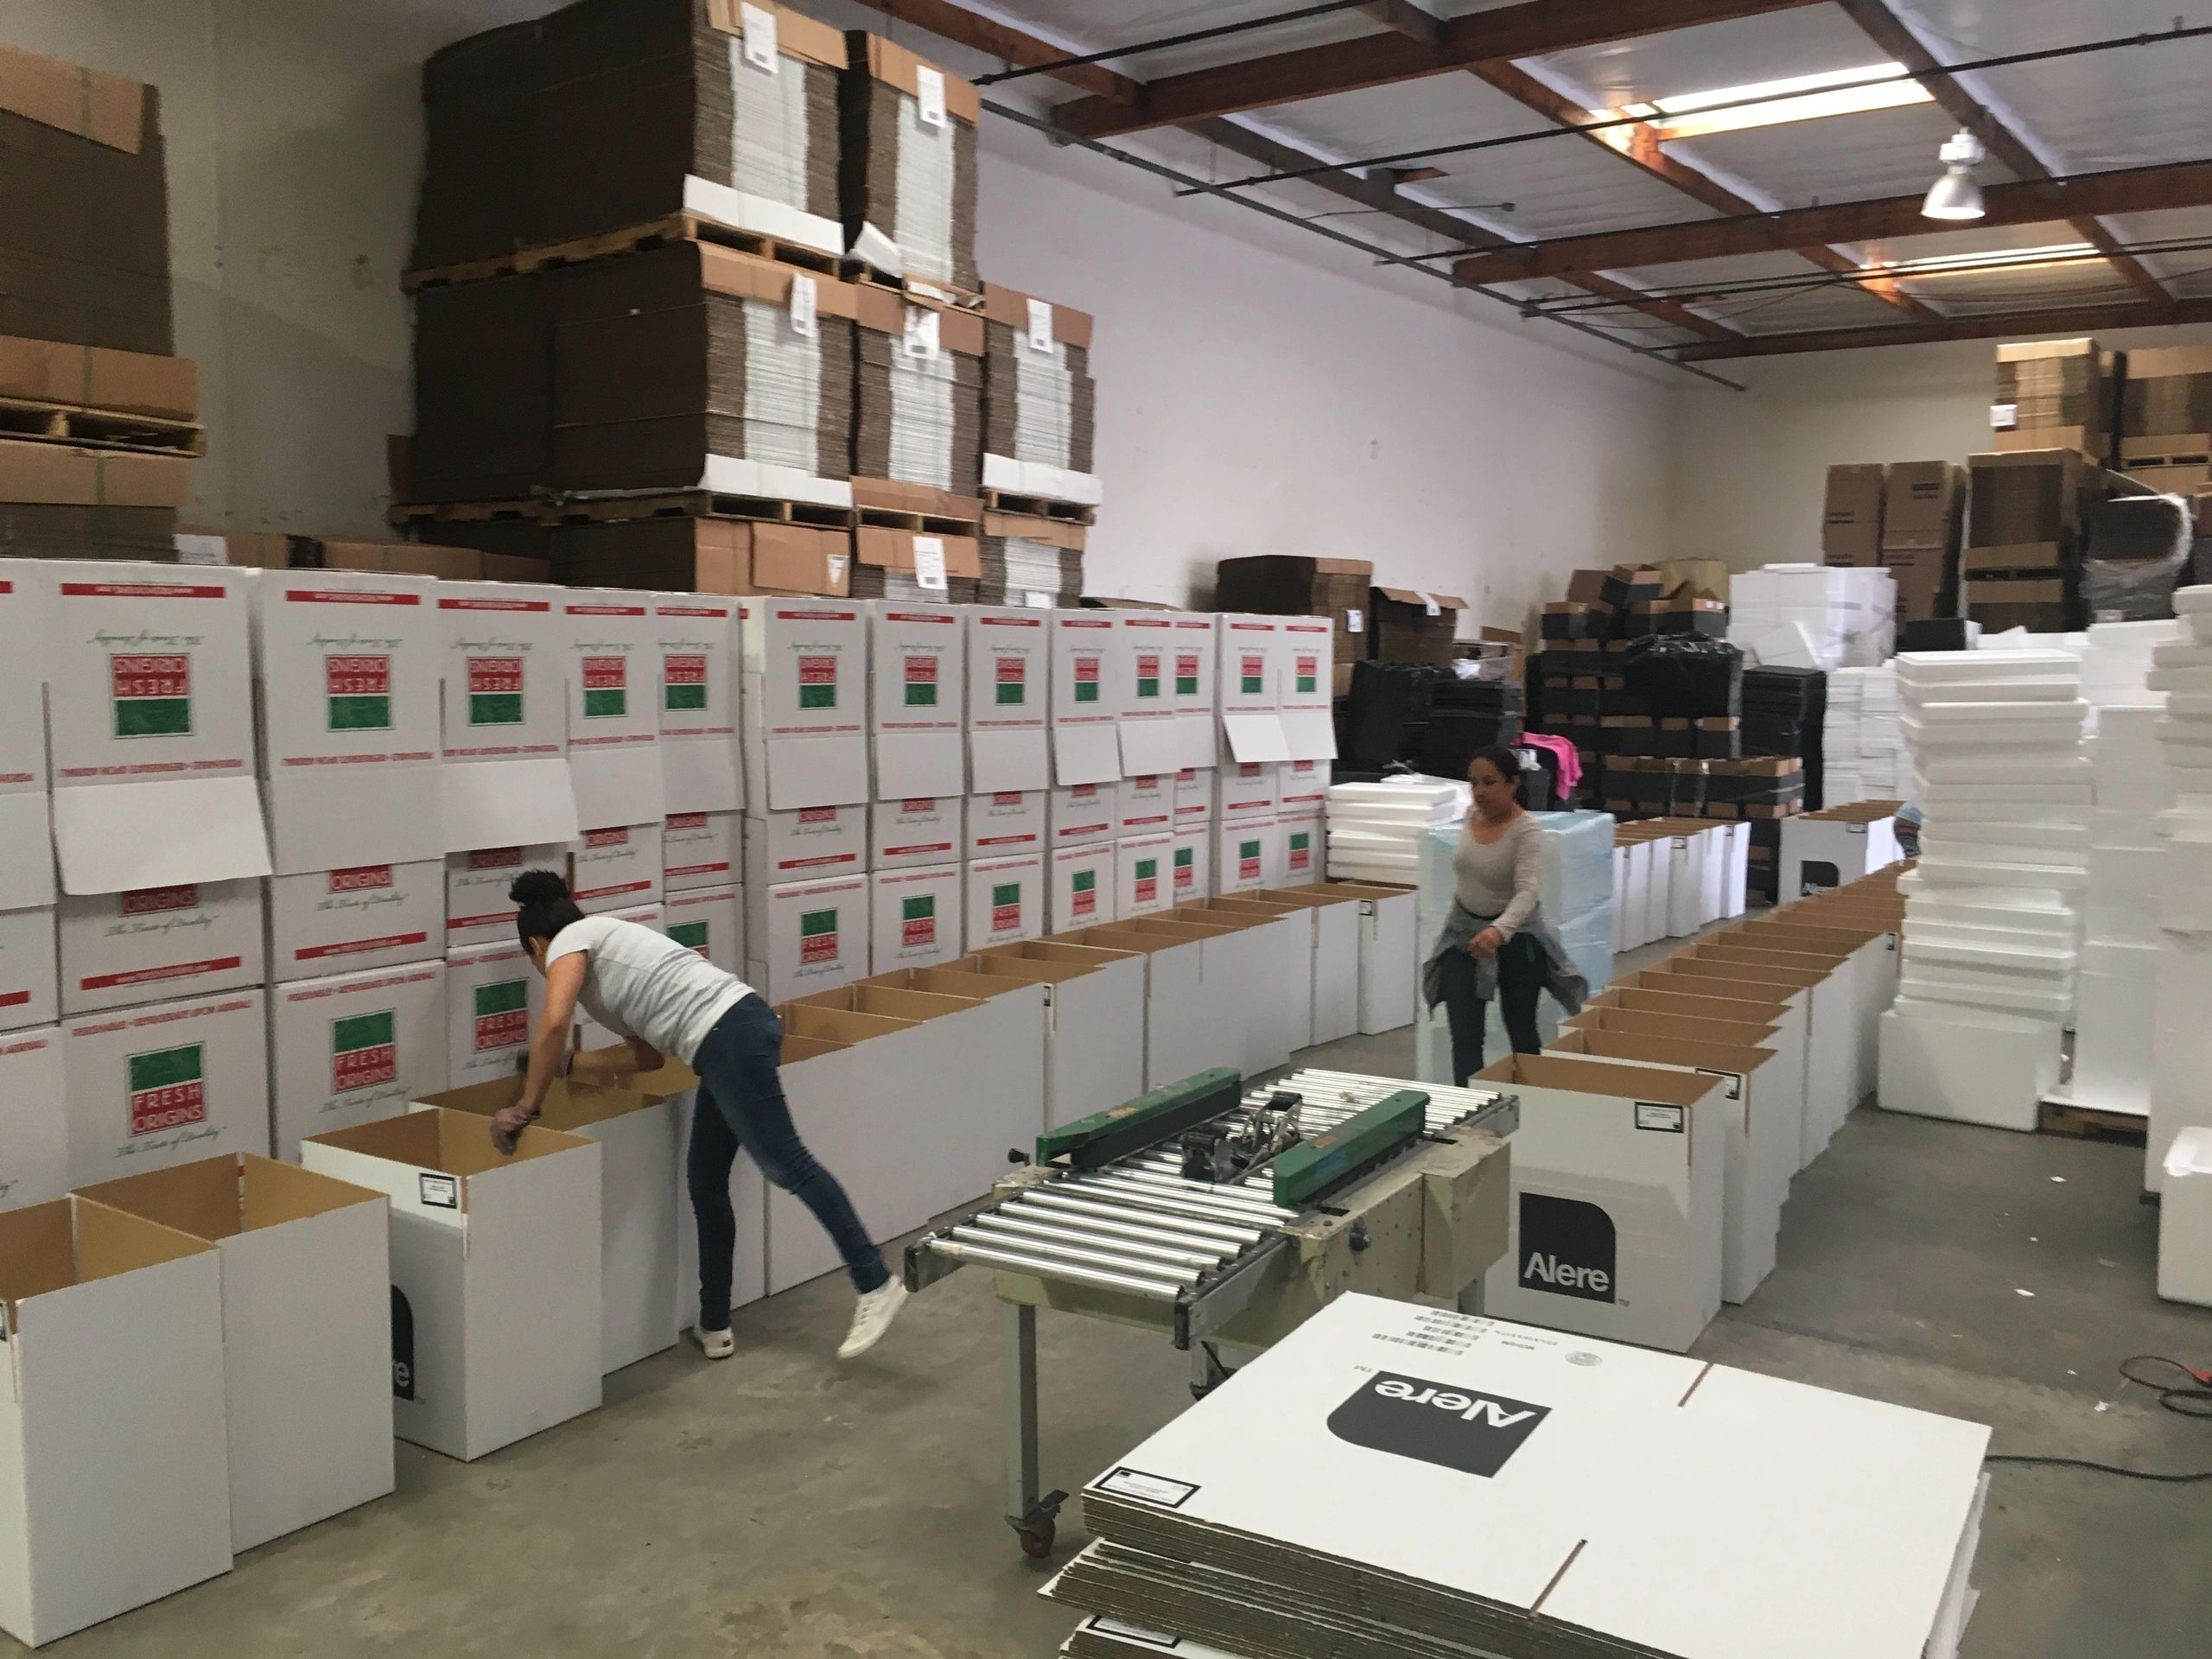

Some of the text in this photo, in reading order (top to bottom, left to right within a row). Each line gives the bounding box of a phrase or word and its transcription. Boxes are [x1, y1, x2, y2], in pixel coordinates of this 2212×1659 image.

[338, 1047, 391, 1067] FRESH
[135, 1085, 201, 1109] FRESH
[1523, 1252, 1609, 1292] Alere
[1375, 1380, 1537, 1428] Alere
